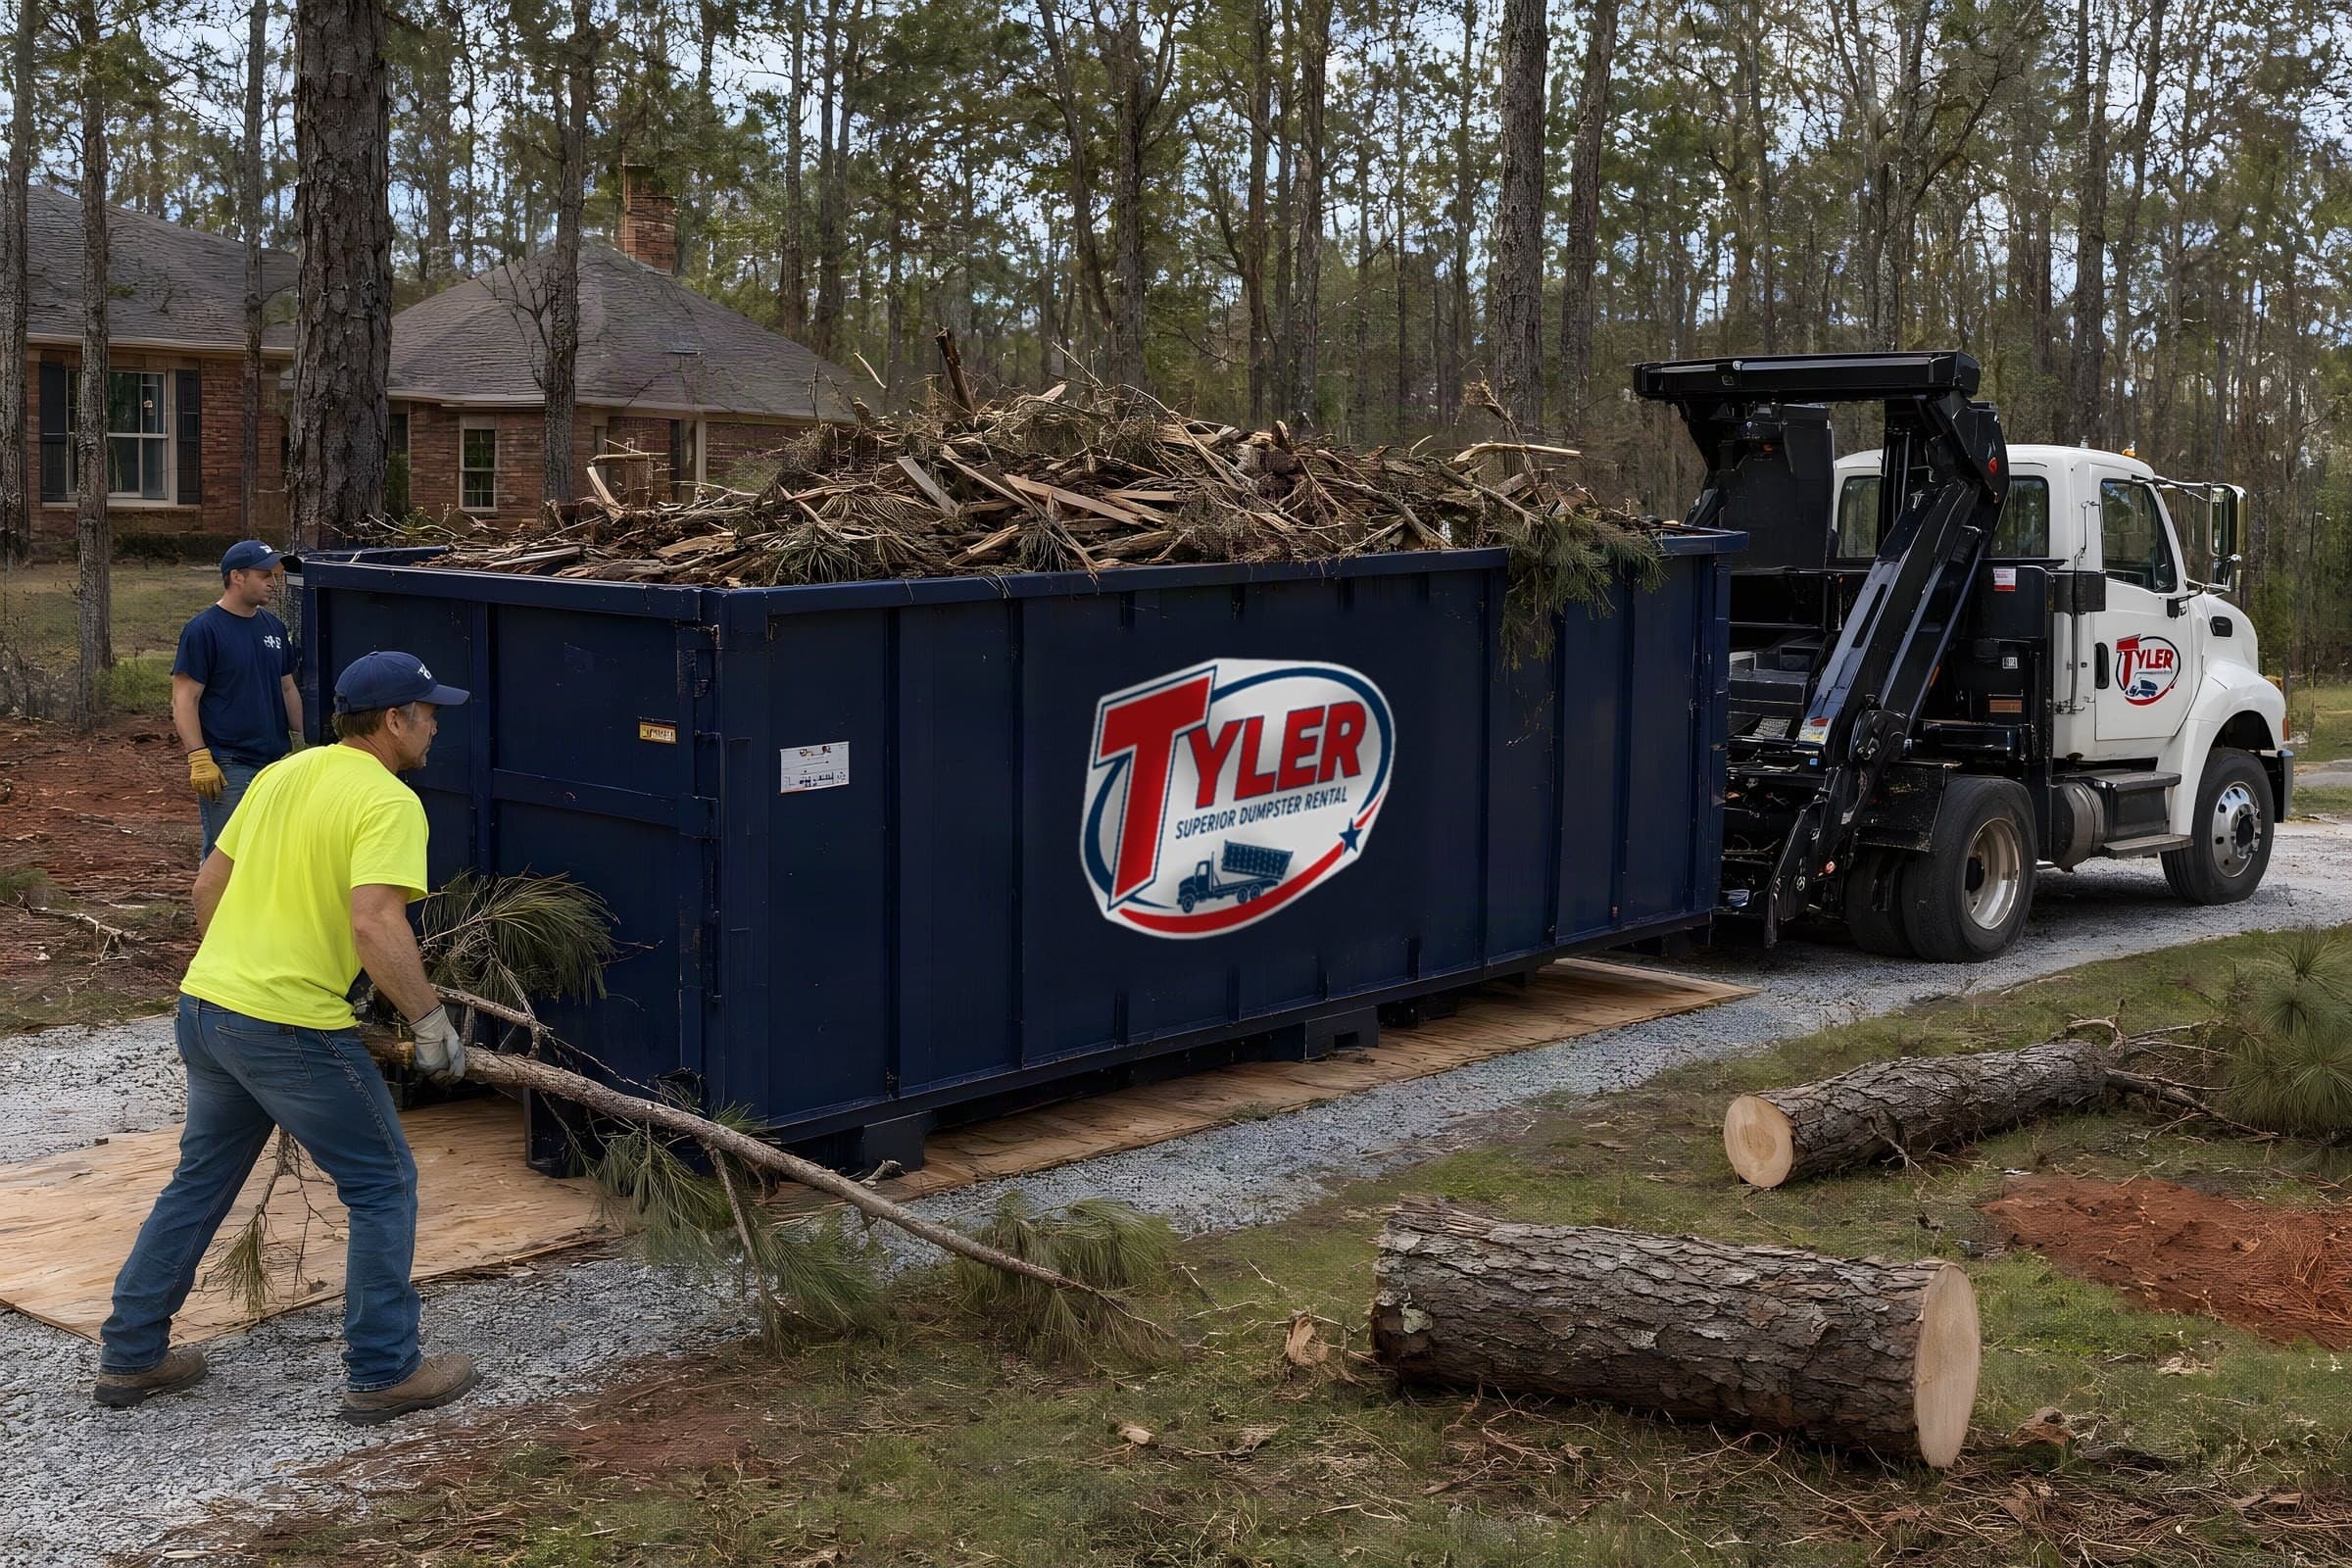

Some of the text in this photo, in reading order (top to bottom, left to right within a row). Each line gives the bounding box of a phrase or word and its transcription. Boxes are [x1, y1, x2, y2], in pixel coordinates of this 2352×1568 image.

[2116, 635, 2174, 689] TYLER
[1095, 667, 1367, 908] TYLER
[1175, 786, 1348, 840] SUPERIOR DUMPSTER RENTAL
